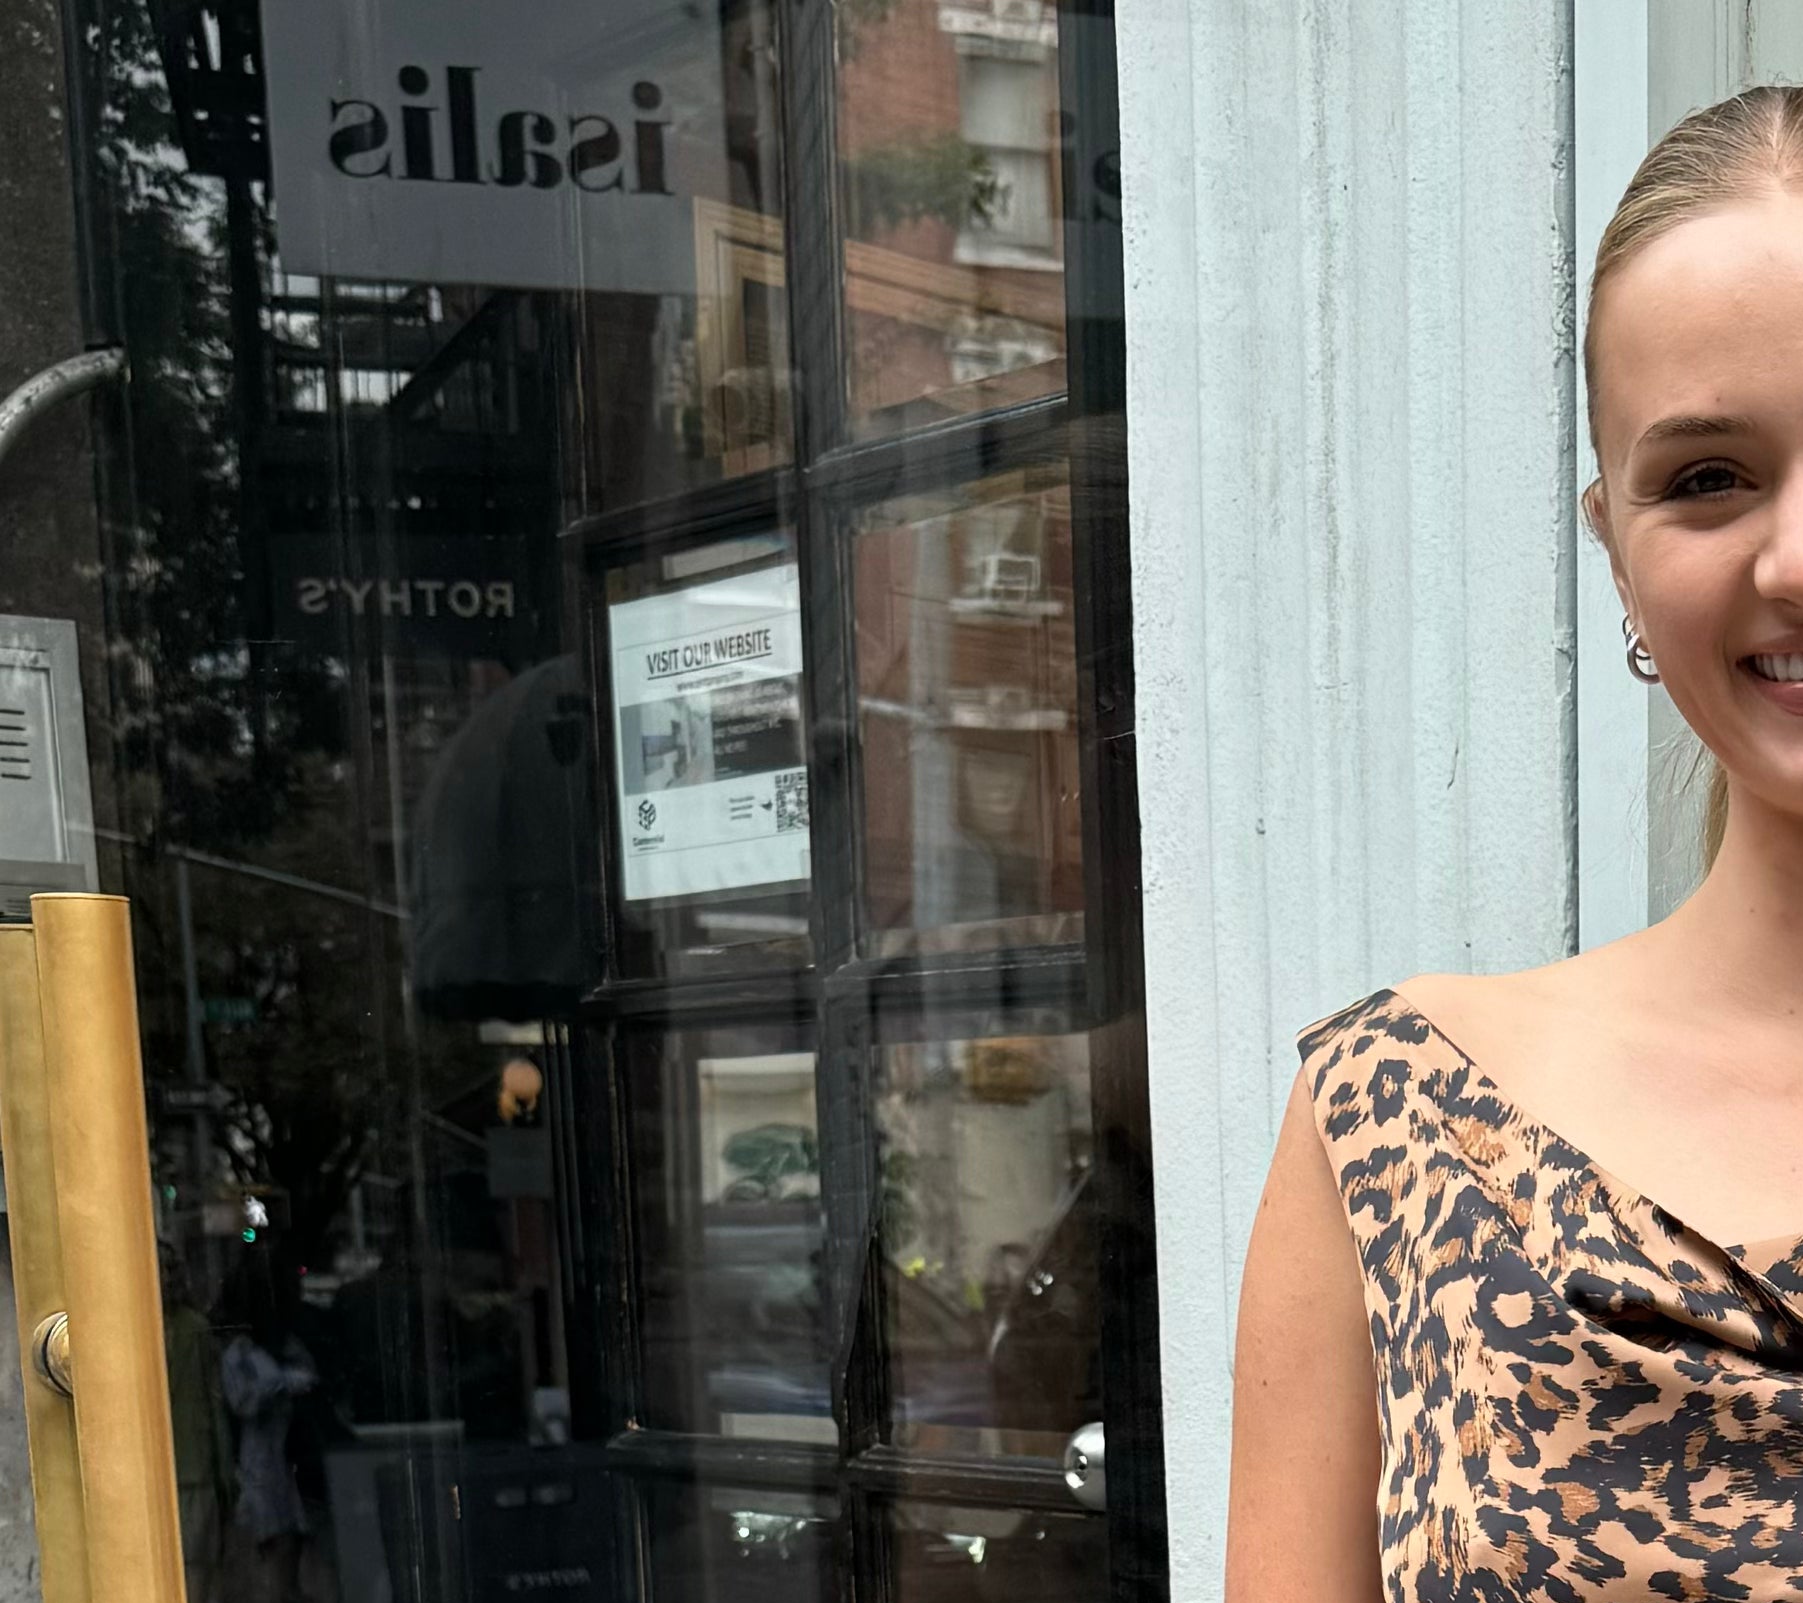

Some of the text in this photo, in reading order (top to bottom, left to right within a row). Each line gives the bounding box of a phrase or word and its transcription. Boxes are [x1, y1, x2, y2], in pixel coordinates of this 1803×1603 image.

[647, 628, 772, 675] VISIT OUR WEBSITE
